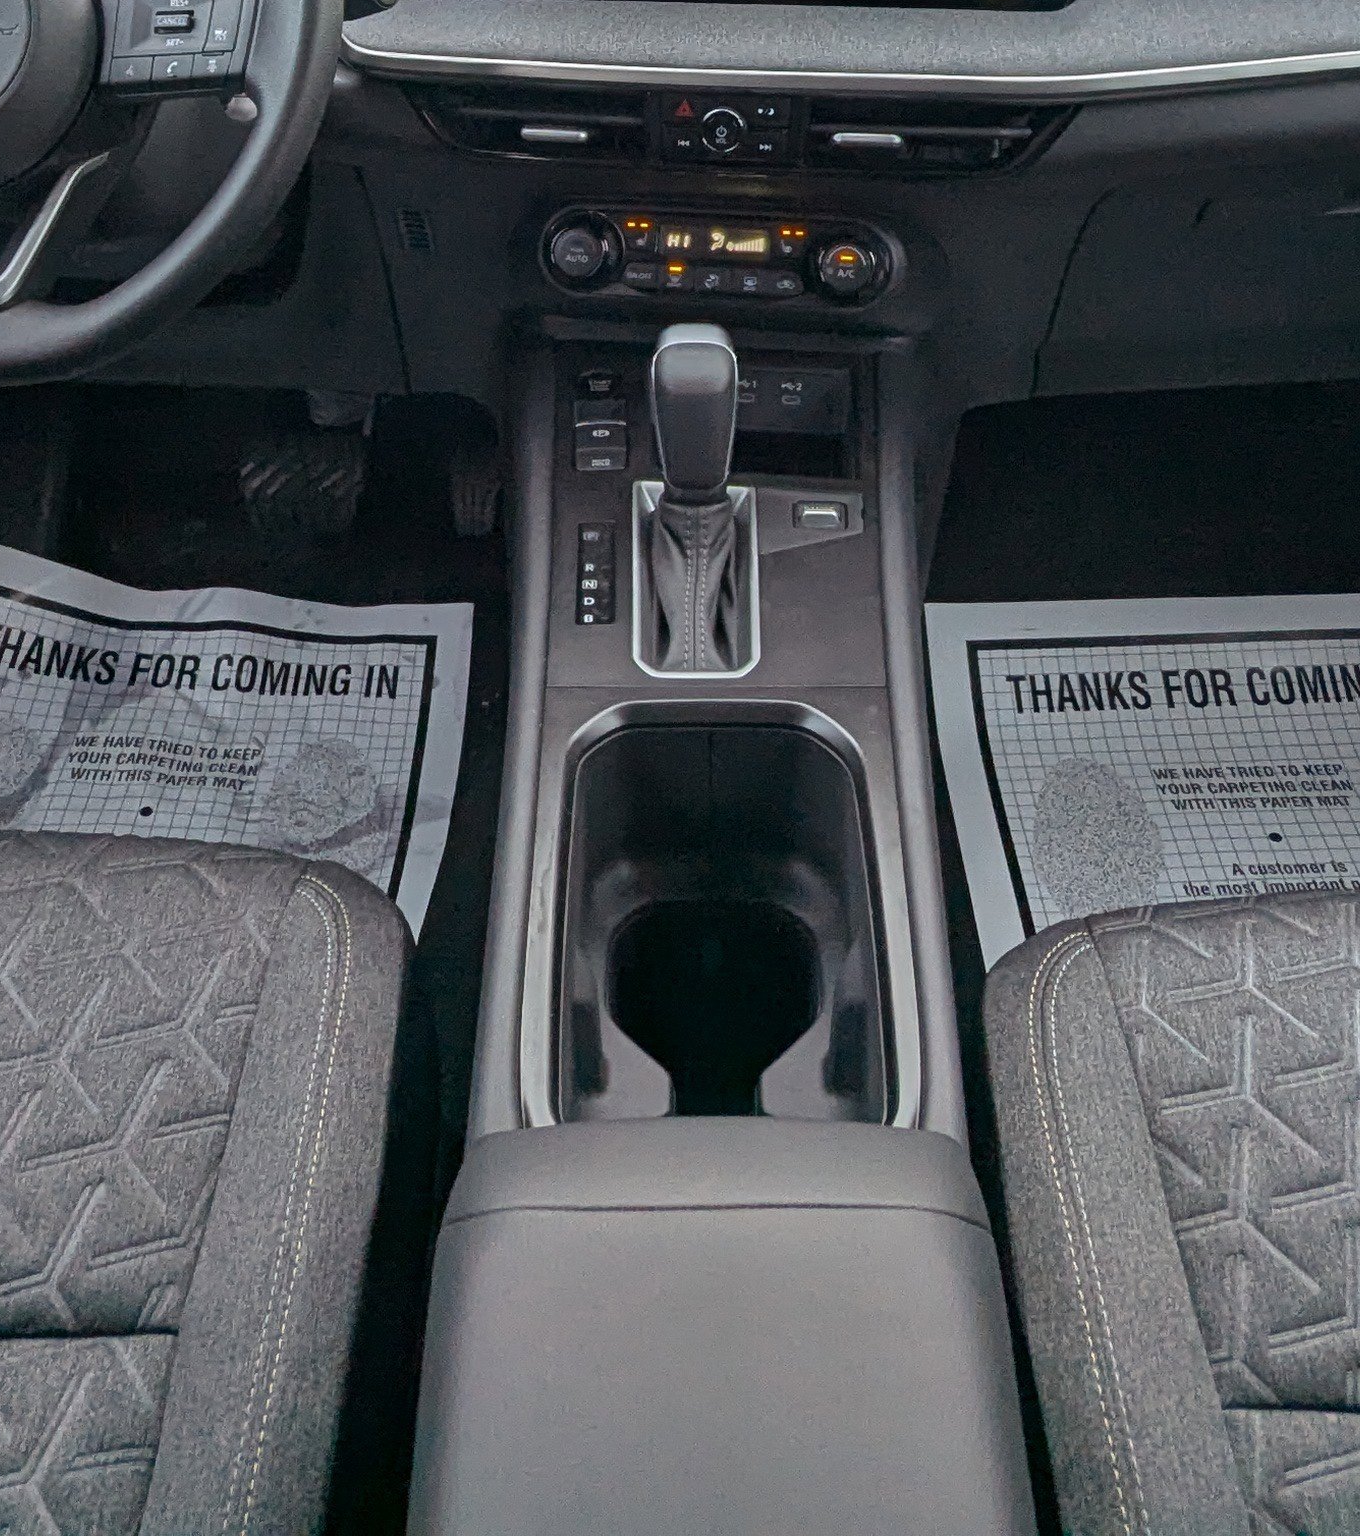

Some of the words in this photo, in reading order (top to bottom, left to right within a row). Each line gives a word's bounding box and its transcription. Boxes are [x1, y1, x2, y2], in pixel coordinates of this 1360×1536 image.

[666, 232, 692, 248] HI
[565, 254, 589, 263] AUTO
[837, 269, 855, 279] A/C
[584, 563, 594, 572] R
[583, 596, 595, 605] D
[130, 651, 202, 691] FOR
[211, 653, 352, 698] COMING
[363, 663, 400, 700] IN
[1007, 670, 1152, 715] THANKS
[1163, 666, 1238, 711] FOR
[74, 735, 99, 748] WE
[102, 735, 144, 748] HAVE
[149, 739, 193, 756] TRIED
[199, 746, 218, 760] TO
[222, 747, 262, 761] KEEP
[68, 750, 112, 765] YOUR
[116, 751, 203, 773] CARPETING
[208, 762, 259, 777] CLEAN
[1152, 767, 1178, 780] WE
[1183, 766, 1224, 780] HAVE
[1229, 765, 1275, 779] TRIED
[1278, 764, 1301, 777] TO
[1302, 763, 1344, 776] KEEP
[70, 767, 112, 782] WITH
[116, 768, 153, 782] THIS
[156, 773, 208, 787] PAPER
[212, 776, 248, 791] MAT
[1156, 782, 1202, 796] YOUR
[1207, 780, 1298, 795] CARPETING
[1301, 779, 1353, 792] CLEAN
[1170, 797, 1216, 811] WITH
[1220, 796, 1257, 810] THIS
[1259, 795, 1313, 809] PAPER
[1316, 794, 1351, 808] MAT
[1232, 863, 1245, 877] A
[1248, 862, 1327, 877] customer
[1331, 861, 1349, 875] is
[1182, 881, 1211, 898] the
[1216, 880, 1260, 897] most
[1262, 877, 1347, 895] important
